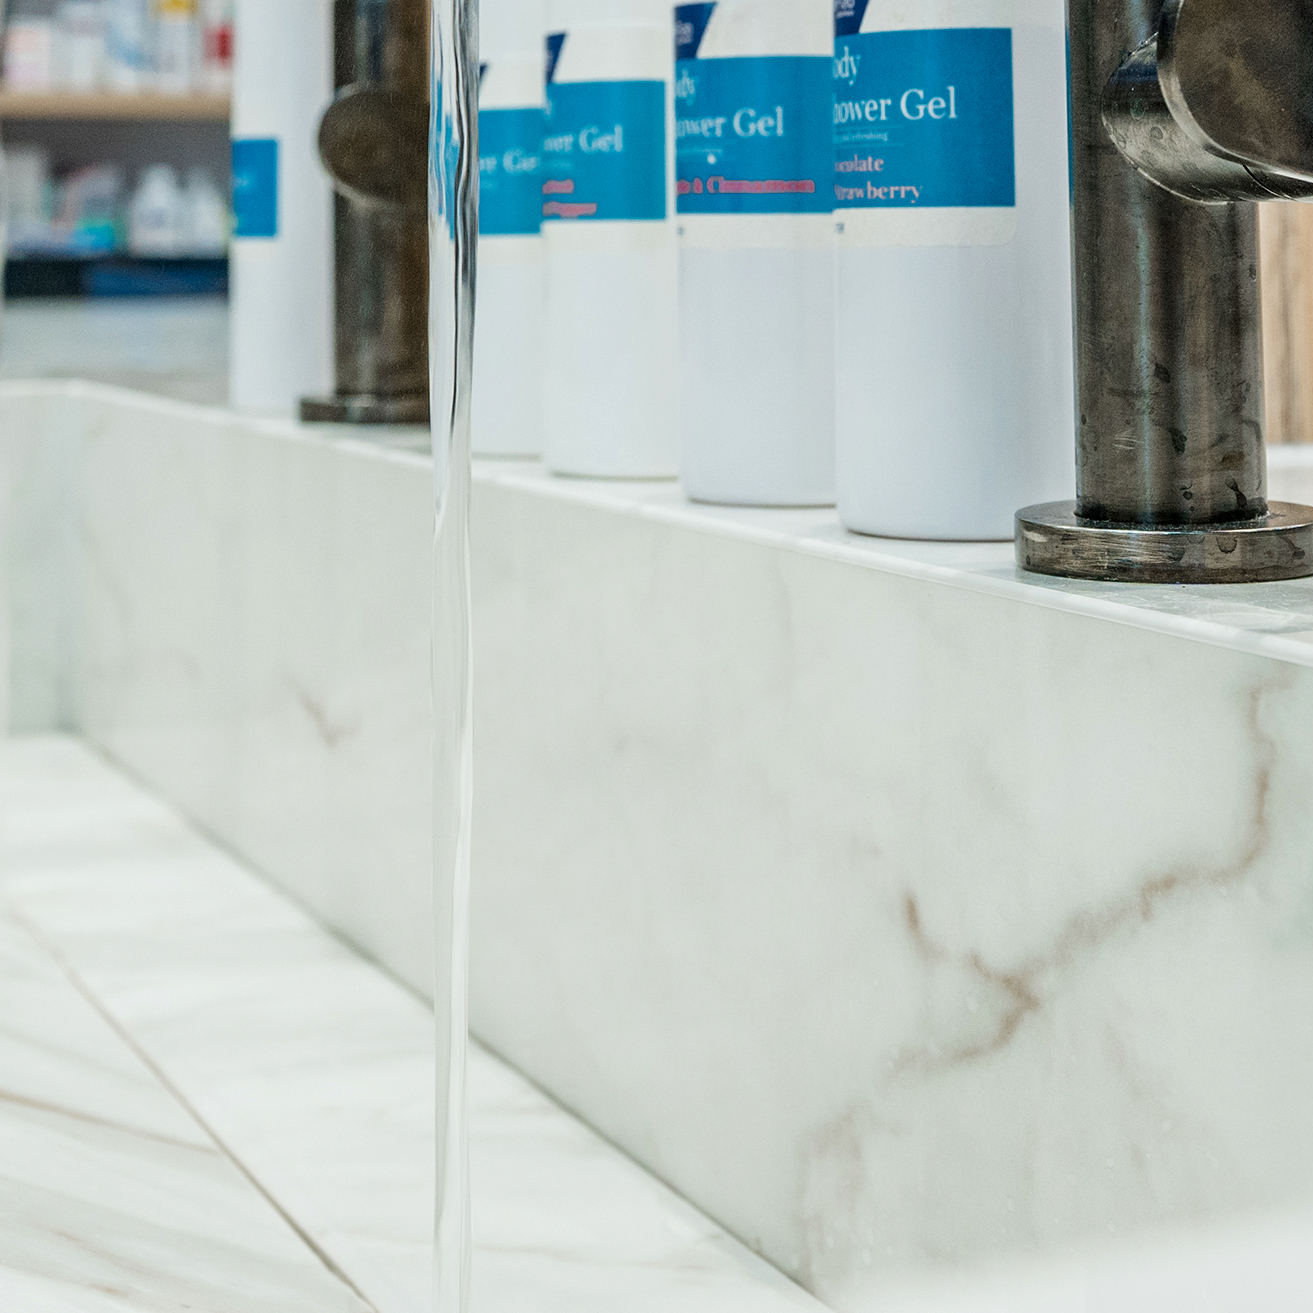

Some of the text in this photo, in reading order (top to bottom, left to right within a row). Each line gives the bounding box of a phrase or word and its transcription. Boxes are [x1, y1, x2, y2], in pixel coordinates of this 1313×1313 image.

[900, 85, 958, 120] Gel
[733, 105, 784, 138] Gel
[502, 149, 540, 175] Ge
